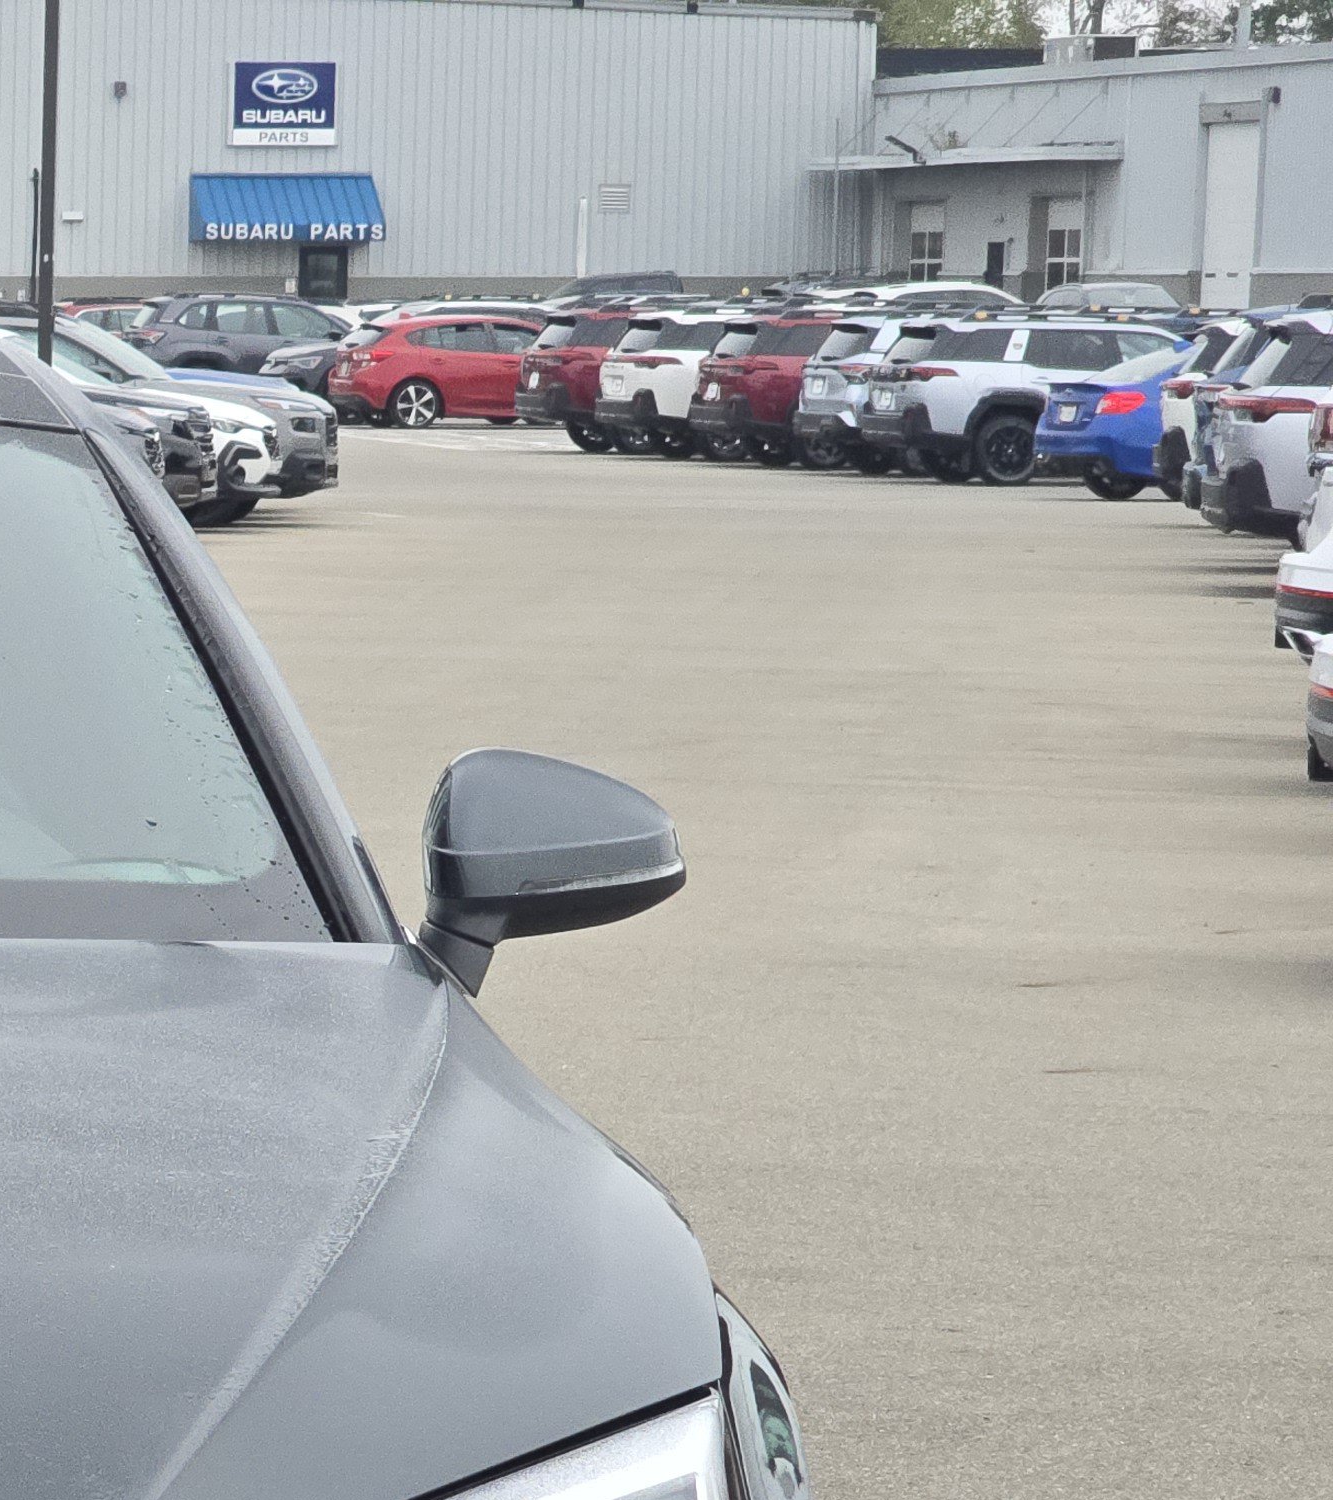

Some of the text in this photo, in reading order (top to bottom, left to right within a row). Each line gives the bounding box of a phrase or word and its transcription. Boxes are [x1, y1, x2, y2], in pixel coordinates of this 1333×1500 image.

[242, 109, 326, 124] SUBARU
[258, 131, 309, 143] PARTS
[205, 223, 383, 240] SUBARU PARTS
